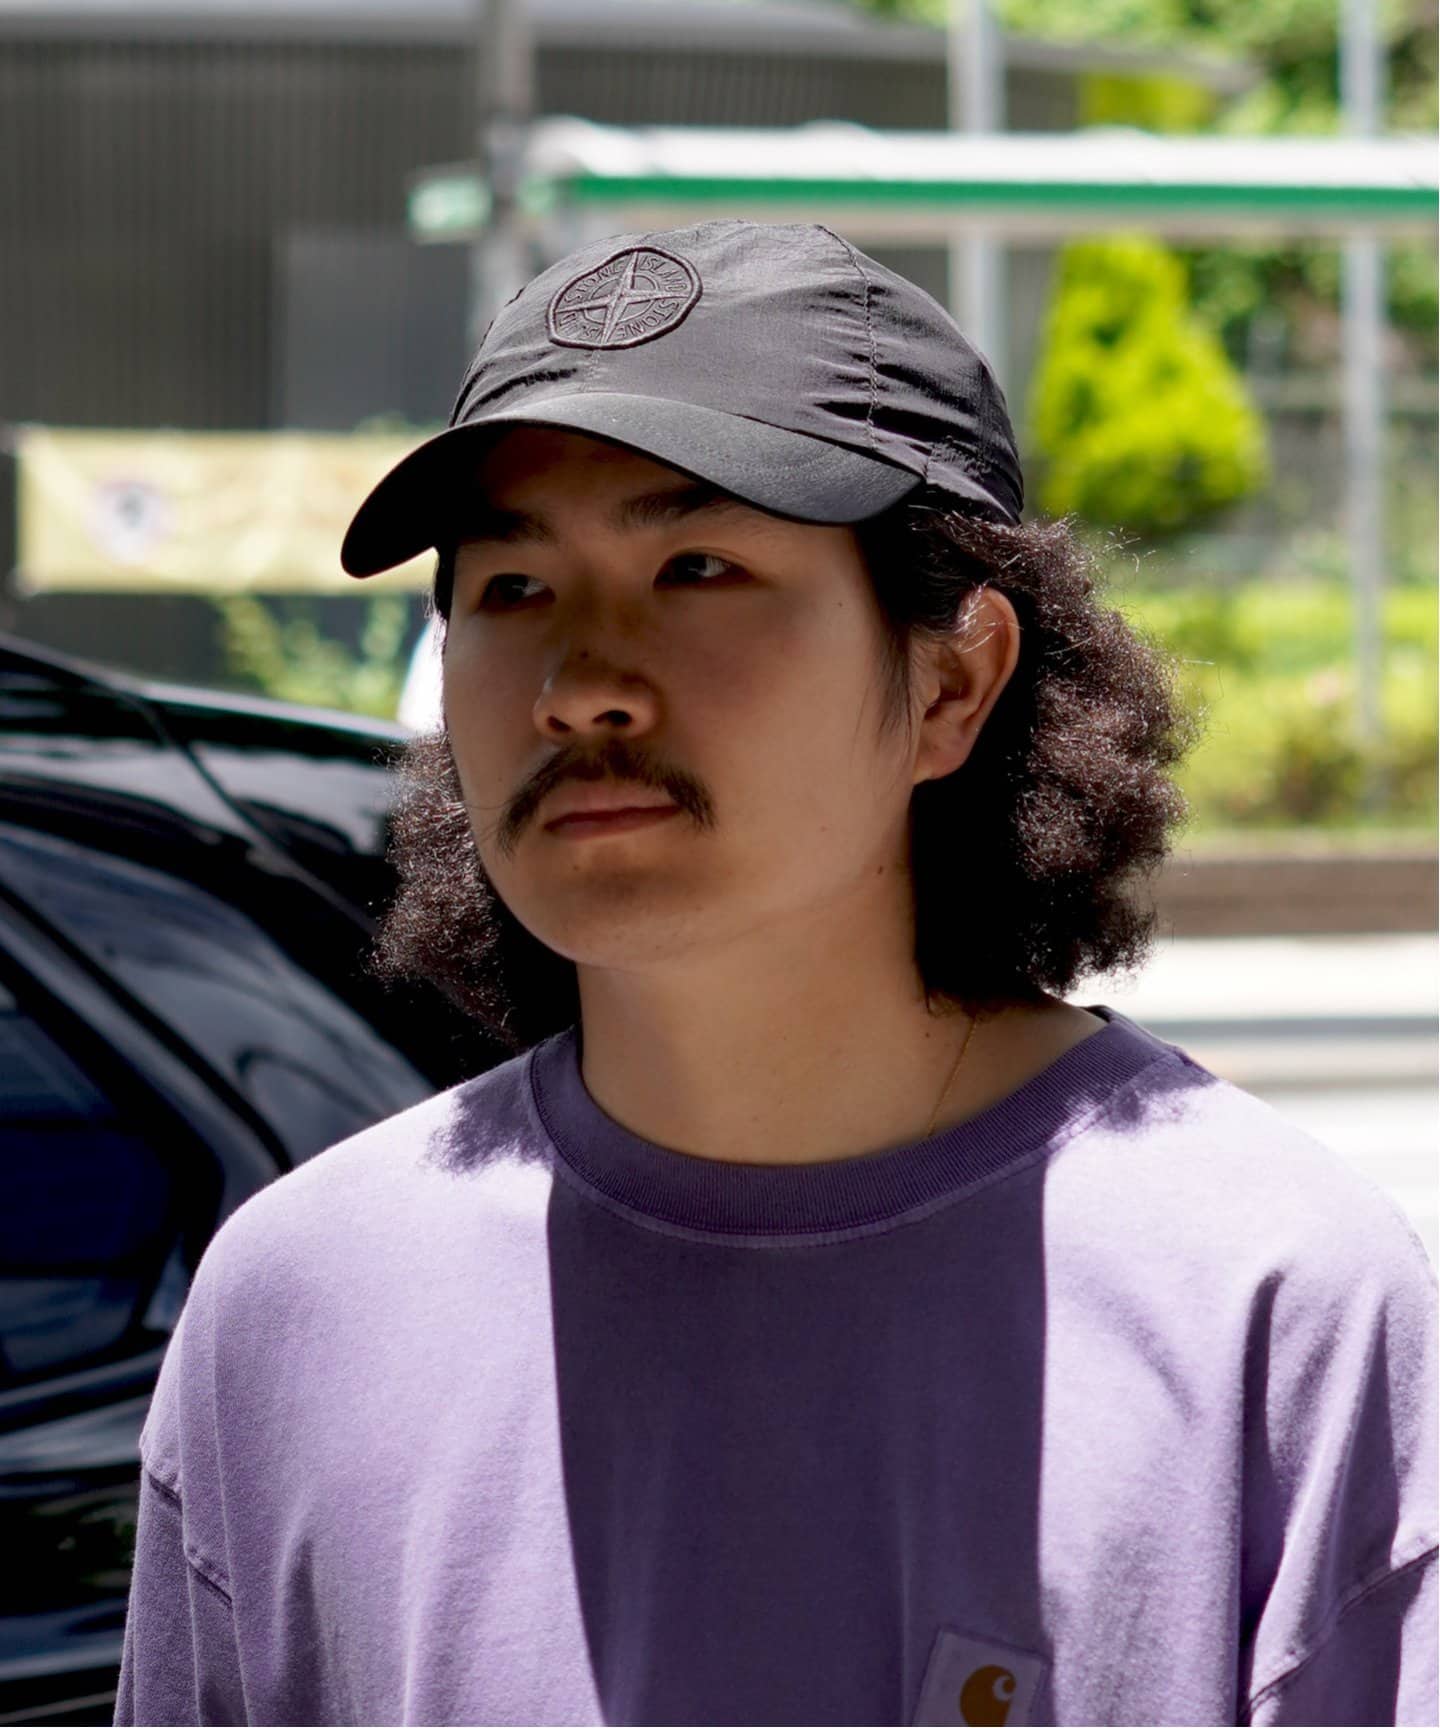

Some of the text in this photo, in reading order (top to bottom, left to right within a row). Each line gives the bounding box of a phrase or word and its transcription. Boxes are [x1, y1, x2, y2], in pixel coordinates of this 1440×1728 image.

[563, 255, 688, 303] STONE ISLAND
[617, 299, 680, 338] STONE
